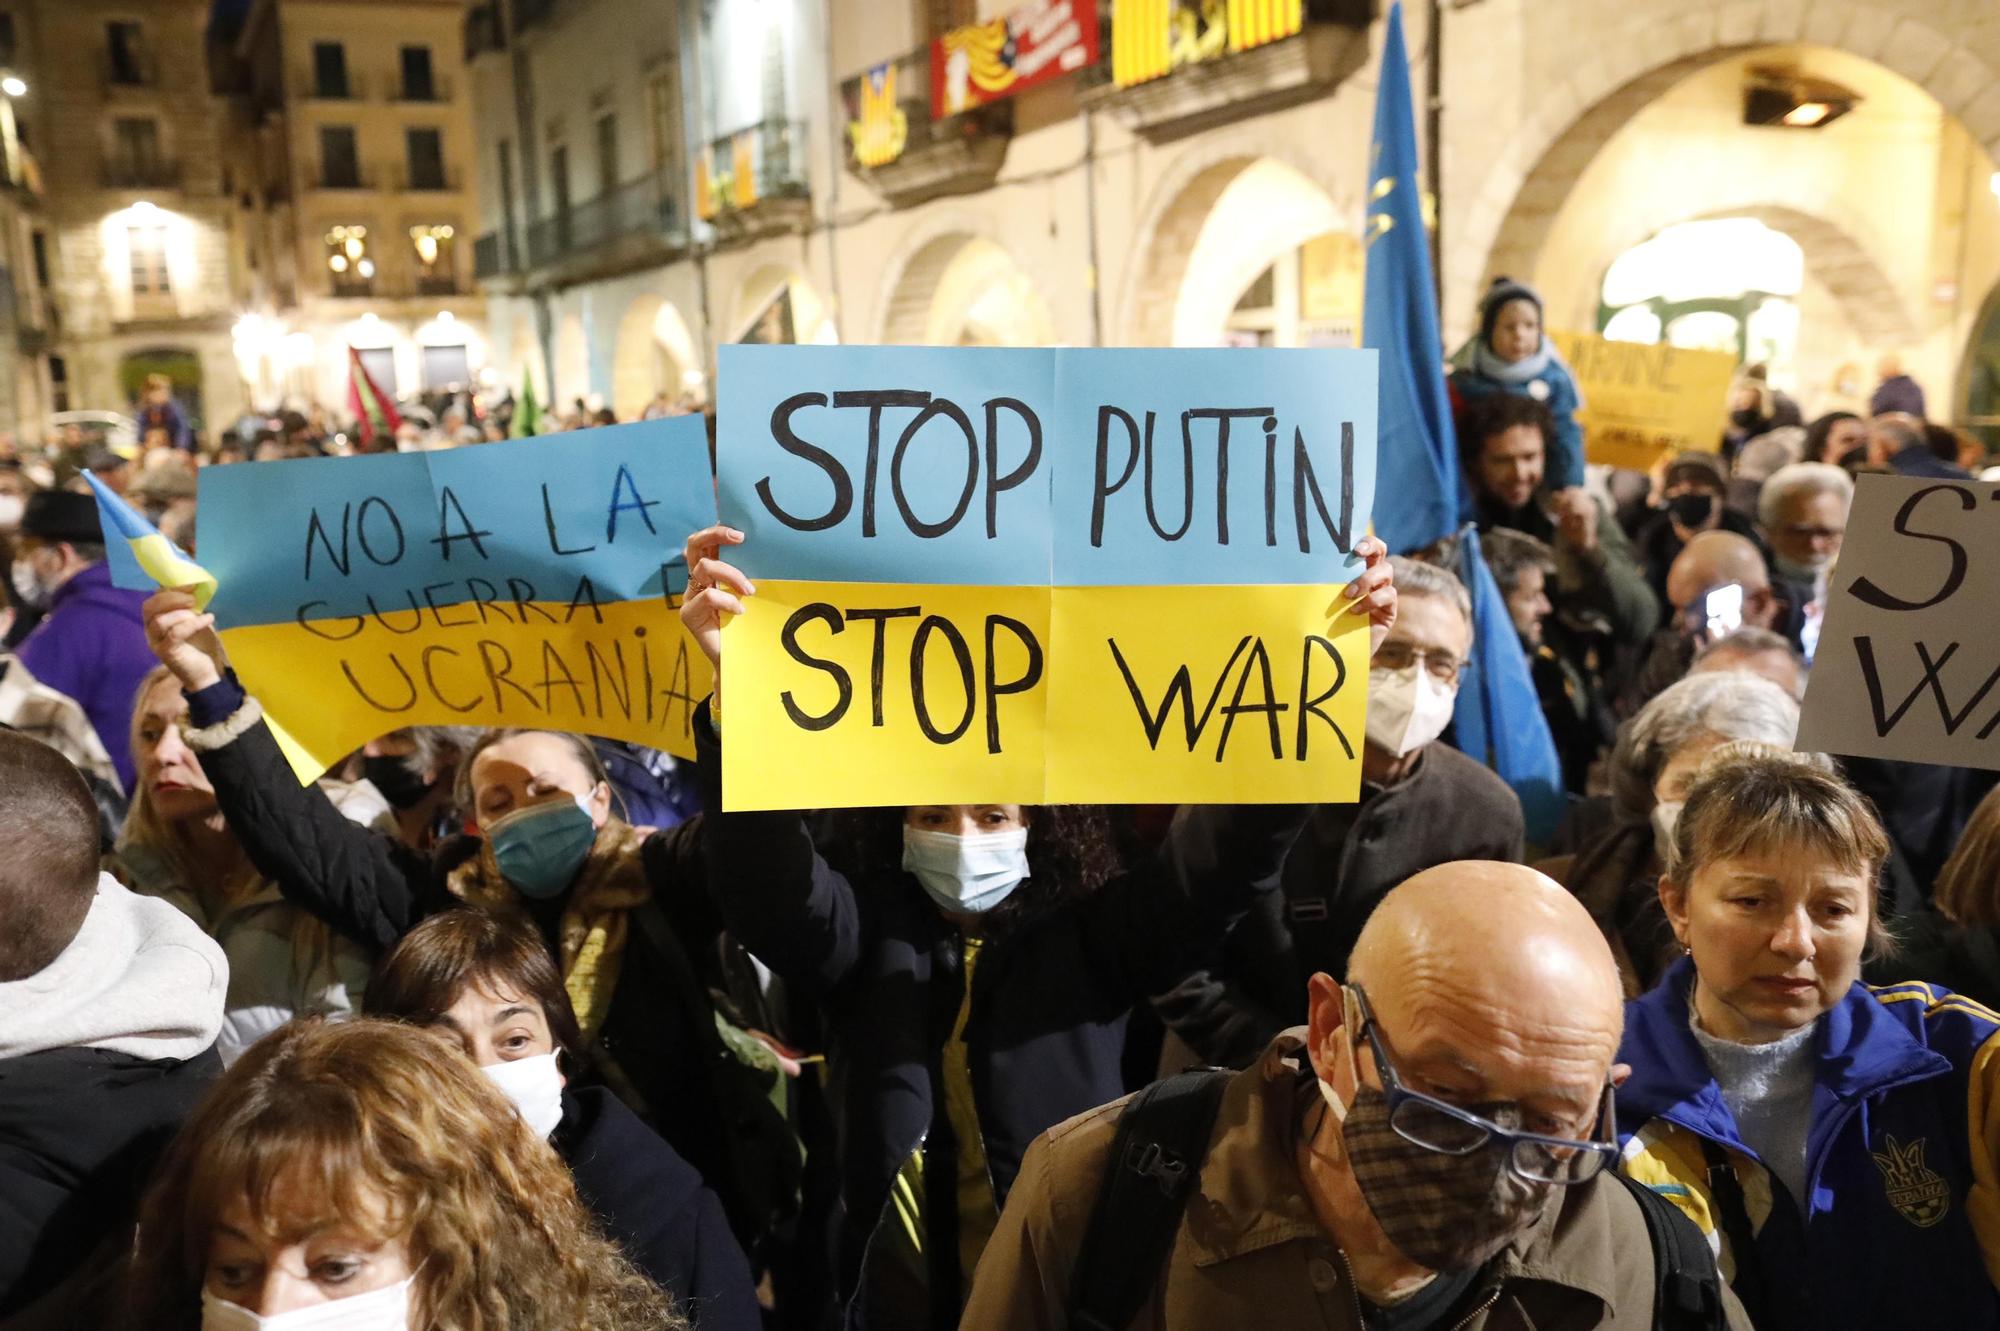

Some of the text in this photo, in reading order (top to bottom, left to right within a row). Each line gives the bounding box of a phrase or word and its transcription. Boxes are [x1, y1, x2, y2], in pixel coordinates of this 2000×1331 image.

[755, 389, 1044, 540] STOP
[303, 496, 406, 582] NO
[430, 485, 492, 562] A
[1847, 484, 2000, 611] S
[296, 573, 617, 642] GUERRA
[780, 602, 1356, 764] STOP WAR
